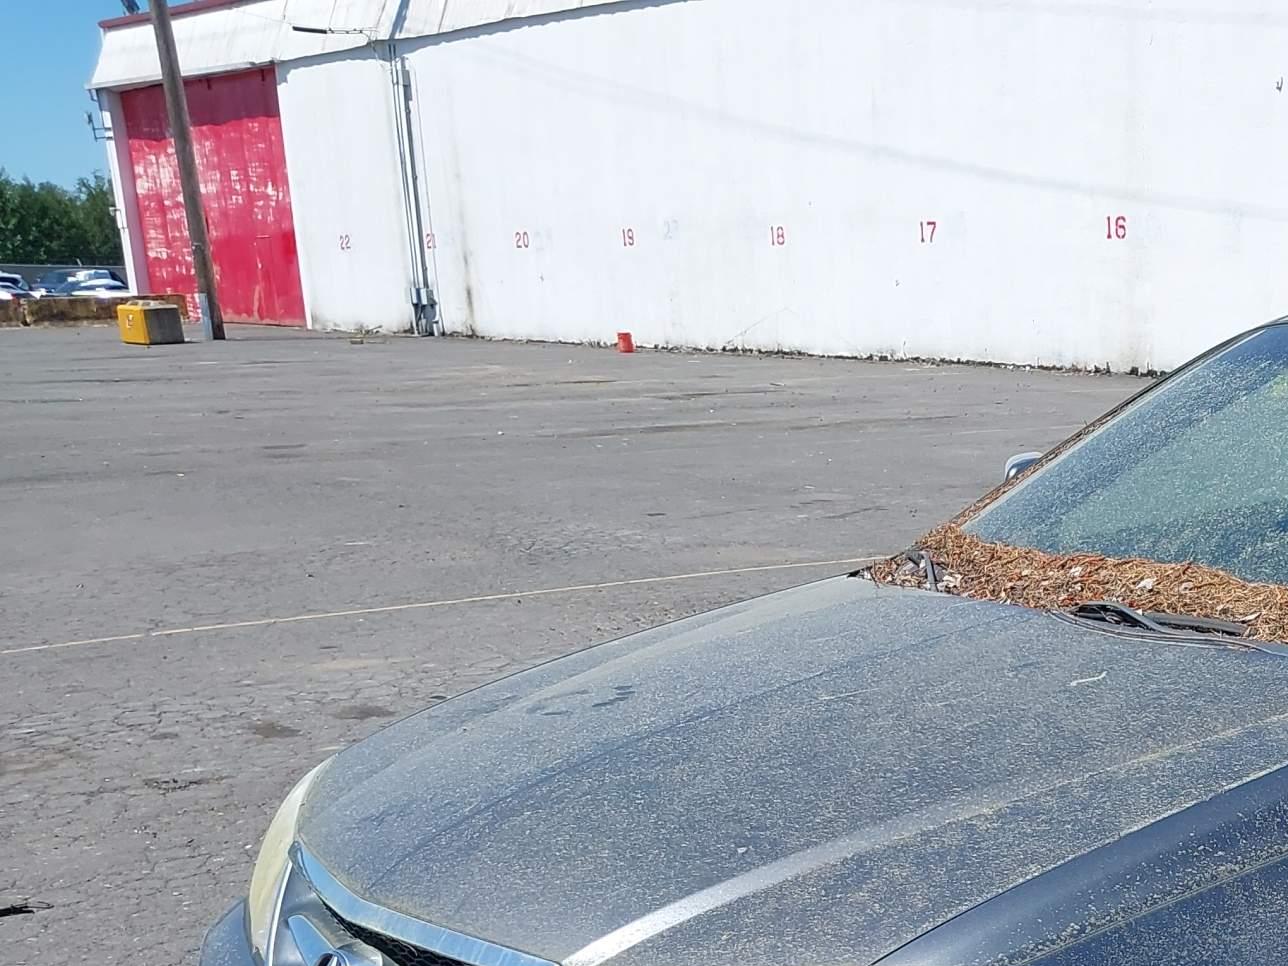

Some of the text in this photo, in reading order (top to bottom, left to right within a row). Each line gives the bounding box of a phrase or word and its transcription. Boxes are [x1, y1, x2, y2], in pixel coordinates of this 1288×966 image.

[621, 228, 635, 247] 19
[769, 225, 786, 247] 18
[919, 220, 937, 243] 17
[1106, 215, 1127, 240] 16
[339, 234, 351, 250] 22
[514, 231, 530, 249] 20
